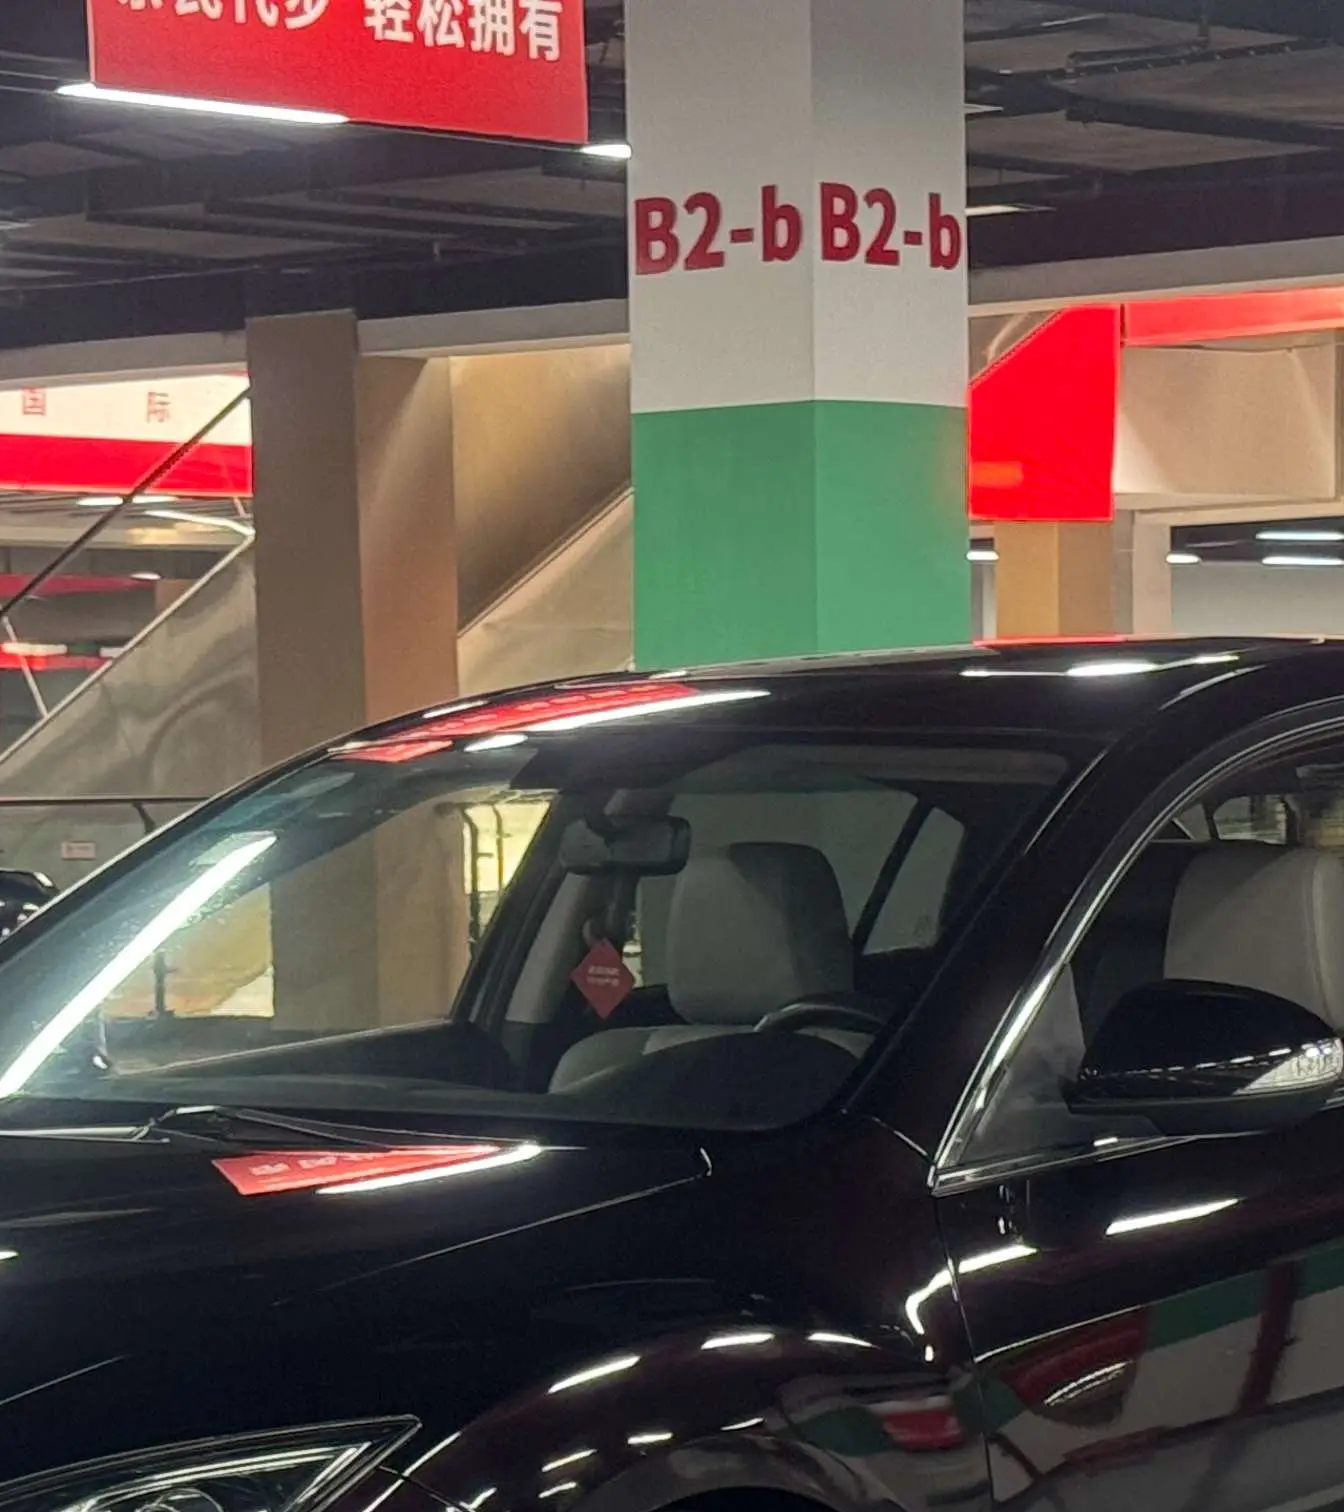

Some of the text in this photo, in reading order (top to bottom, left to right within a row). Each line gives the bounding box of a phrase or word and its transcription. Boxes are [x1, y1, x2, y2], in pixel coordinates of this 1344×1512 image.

[364, 0, 562, 61] 轻松拥有
[634, 185, 803, 275] B2-b
[820, 182, 962, 270] B2-b
